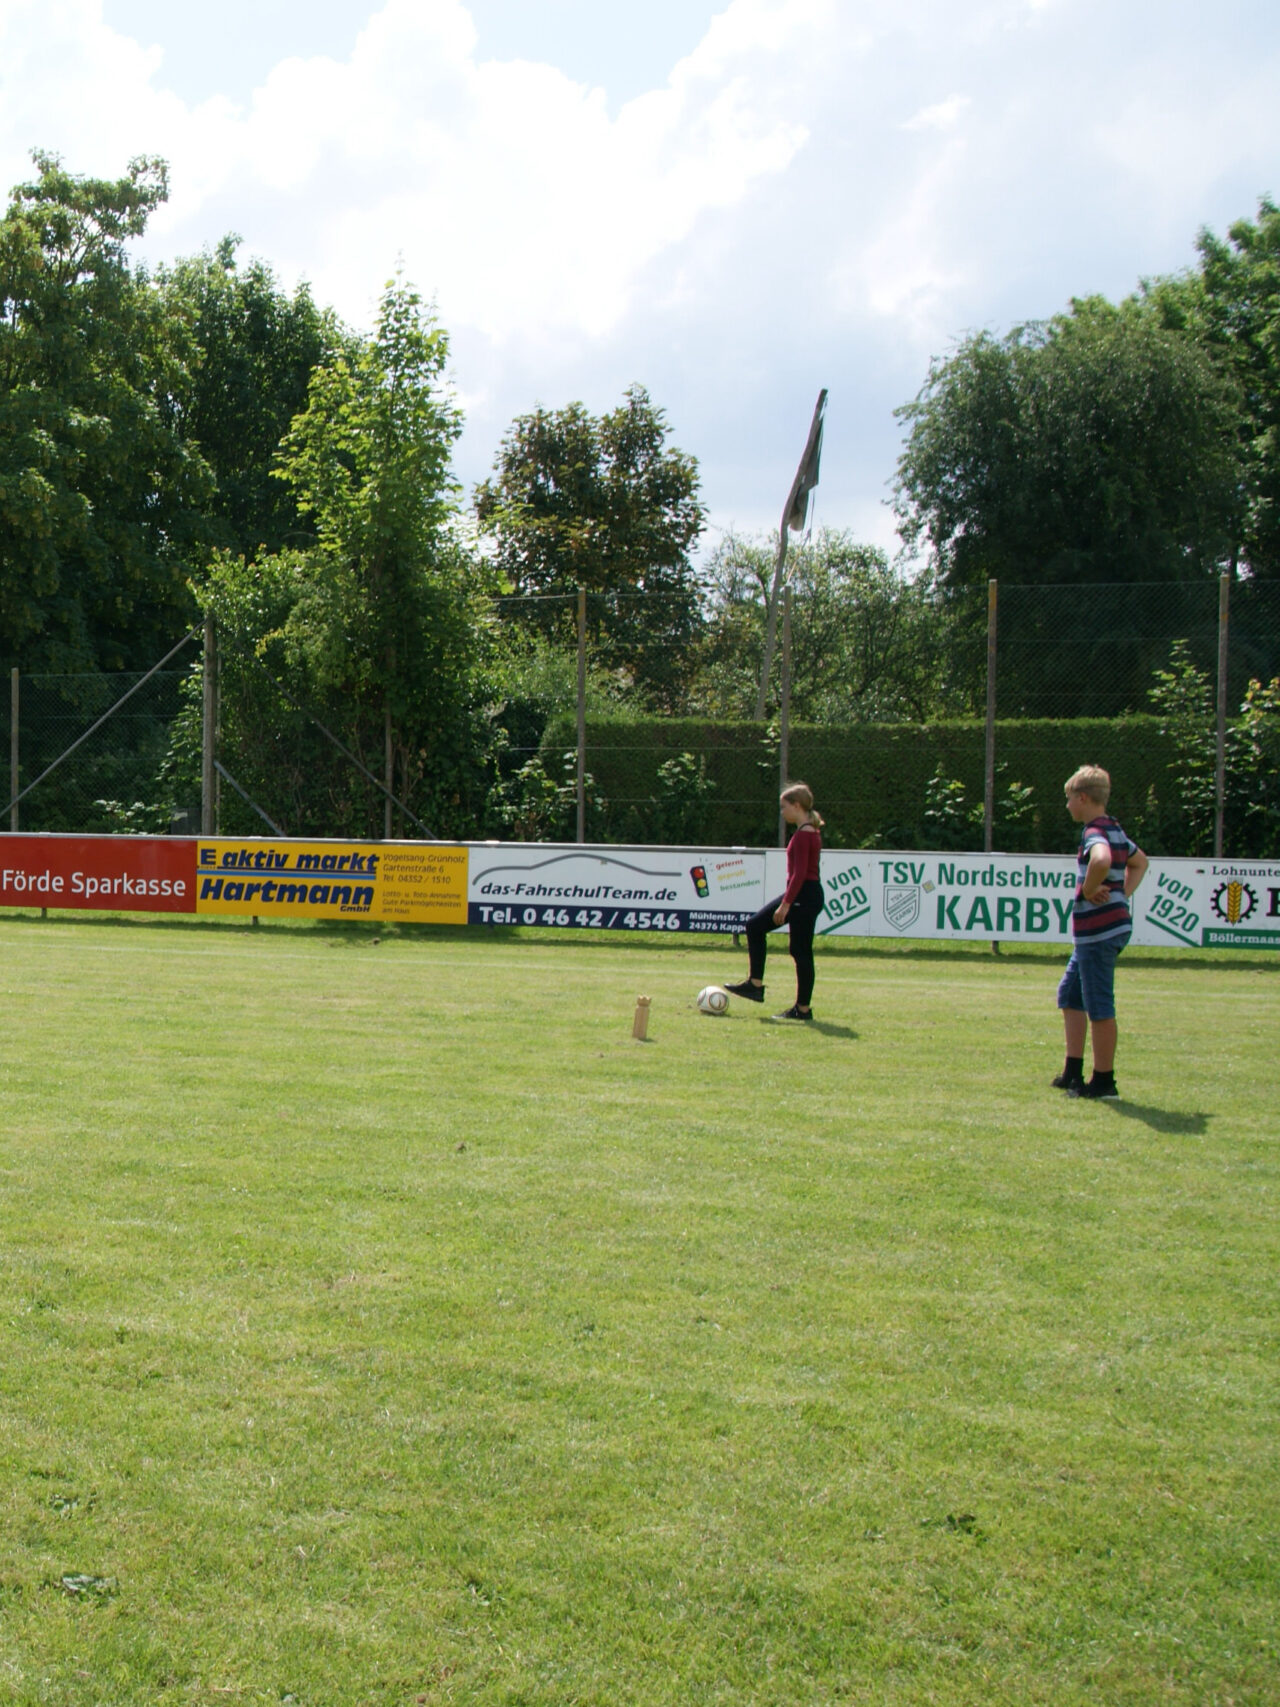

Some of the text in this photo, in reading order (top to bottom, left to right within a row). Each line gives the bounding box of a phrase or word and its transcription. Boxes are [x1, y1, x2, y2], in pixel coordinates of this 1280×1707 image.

[201, 849, 380, 872] E aktiv markt
[383, 854, 425, 863] Vogelsang
[383, 863, 437, 873] Gartenstraße
[715, 859, 744, 870] gelernt
[826, 865, 862, 891] von
[878, 861, 1077, 889] TSV Nordschwa
[1212, 865, 1280, 877] Lohnunte
[3, 869, 186, 898] Förde Sparkasse
[200, 878, 375, 905] Hartmann
[480, 882, 677, 901] das-FahrschulTeam.de
[720, 879, 760, 891] bestanden
[1157, 872, 1194, 902] von
[340, 905, 370, 913] GmbH
[822, 885, 868, 921] 1920
[936, 895, 1075, 934] KARBY
[1149, 894, 1200, 933] 1920
[479, 906, 517, 924] Tel.
[523, 907, 537, 925] 0
[542, 908, 570, 926] 46
[575, 910, 603, 927] 42
[623, 911, 680, 930] 4546
[689, 911, 738, 921] Mühlenstr.
[689, 922, 718, 931] 24376
